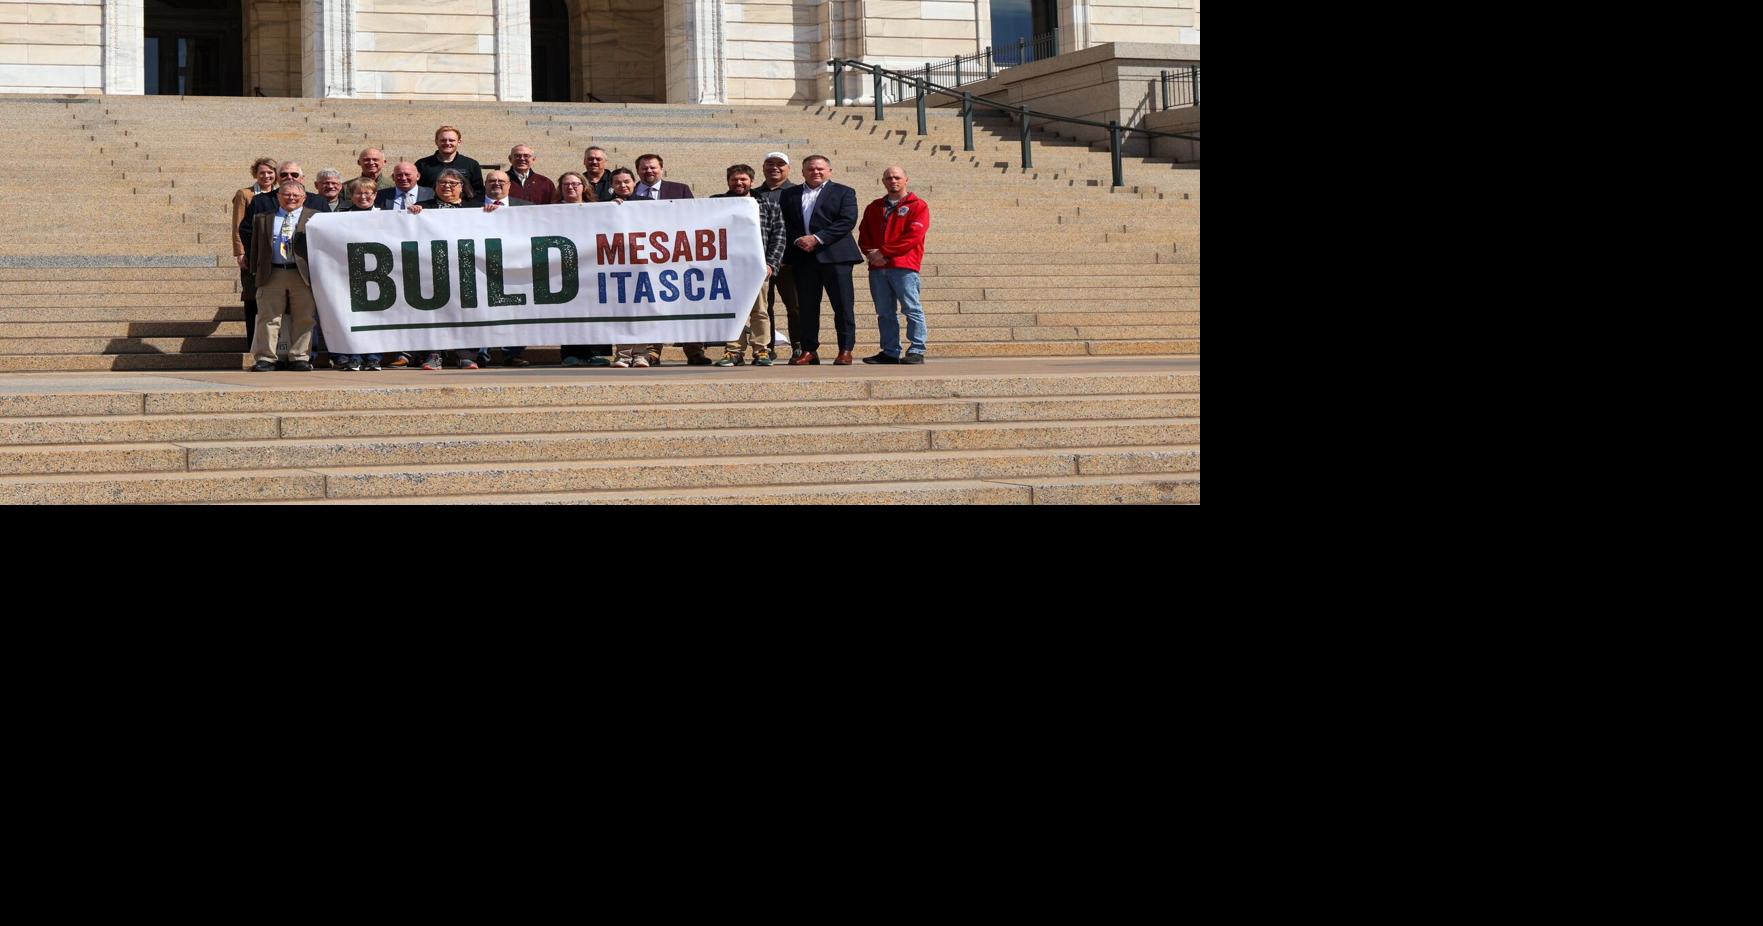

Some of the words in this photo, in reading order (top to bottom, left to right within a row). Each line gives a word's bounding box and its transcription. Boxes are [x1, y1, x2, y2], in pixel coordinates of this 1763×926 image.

[596, 229, 727, 265] MESABI
[347, 236, 579, 312] BUILD
[598, 268, 731, 304] ITASCA
